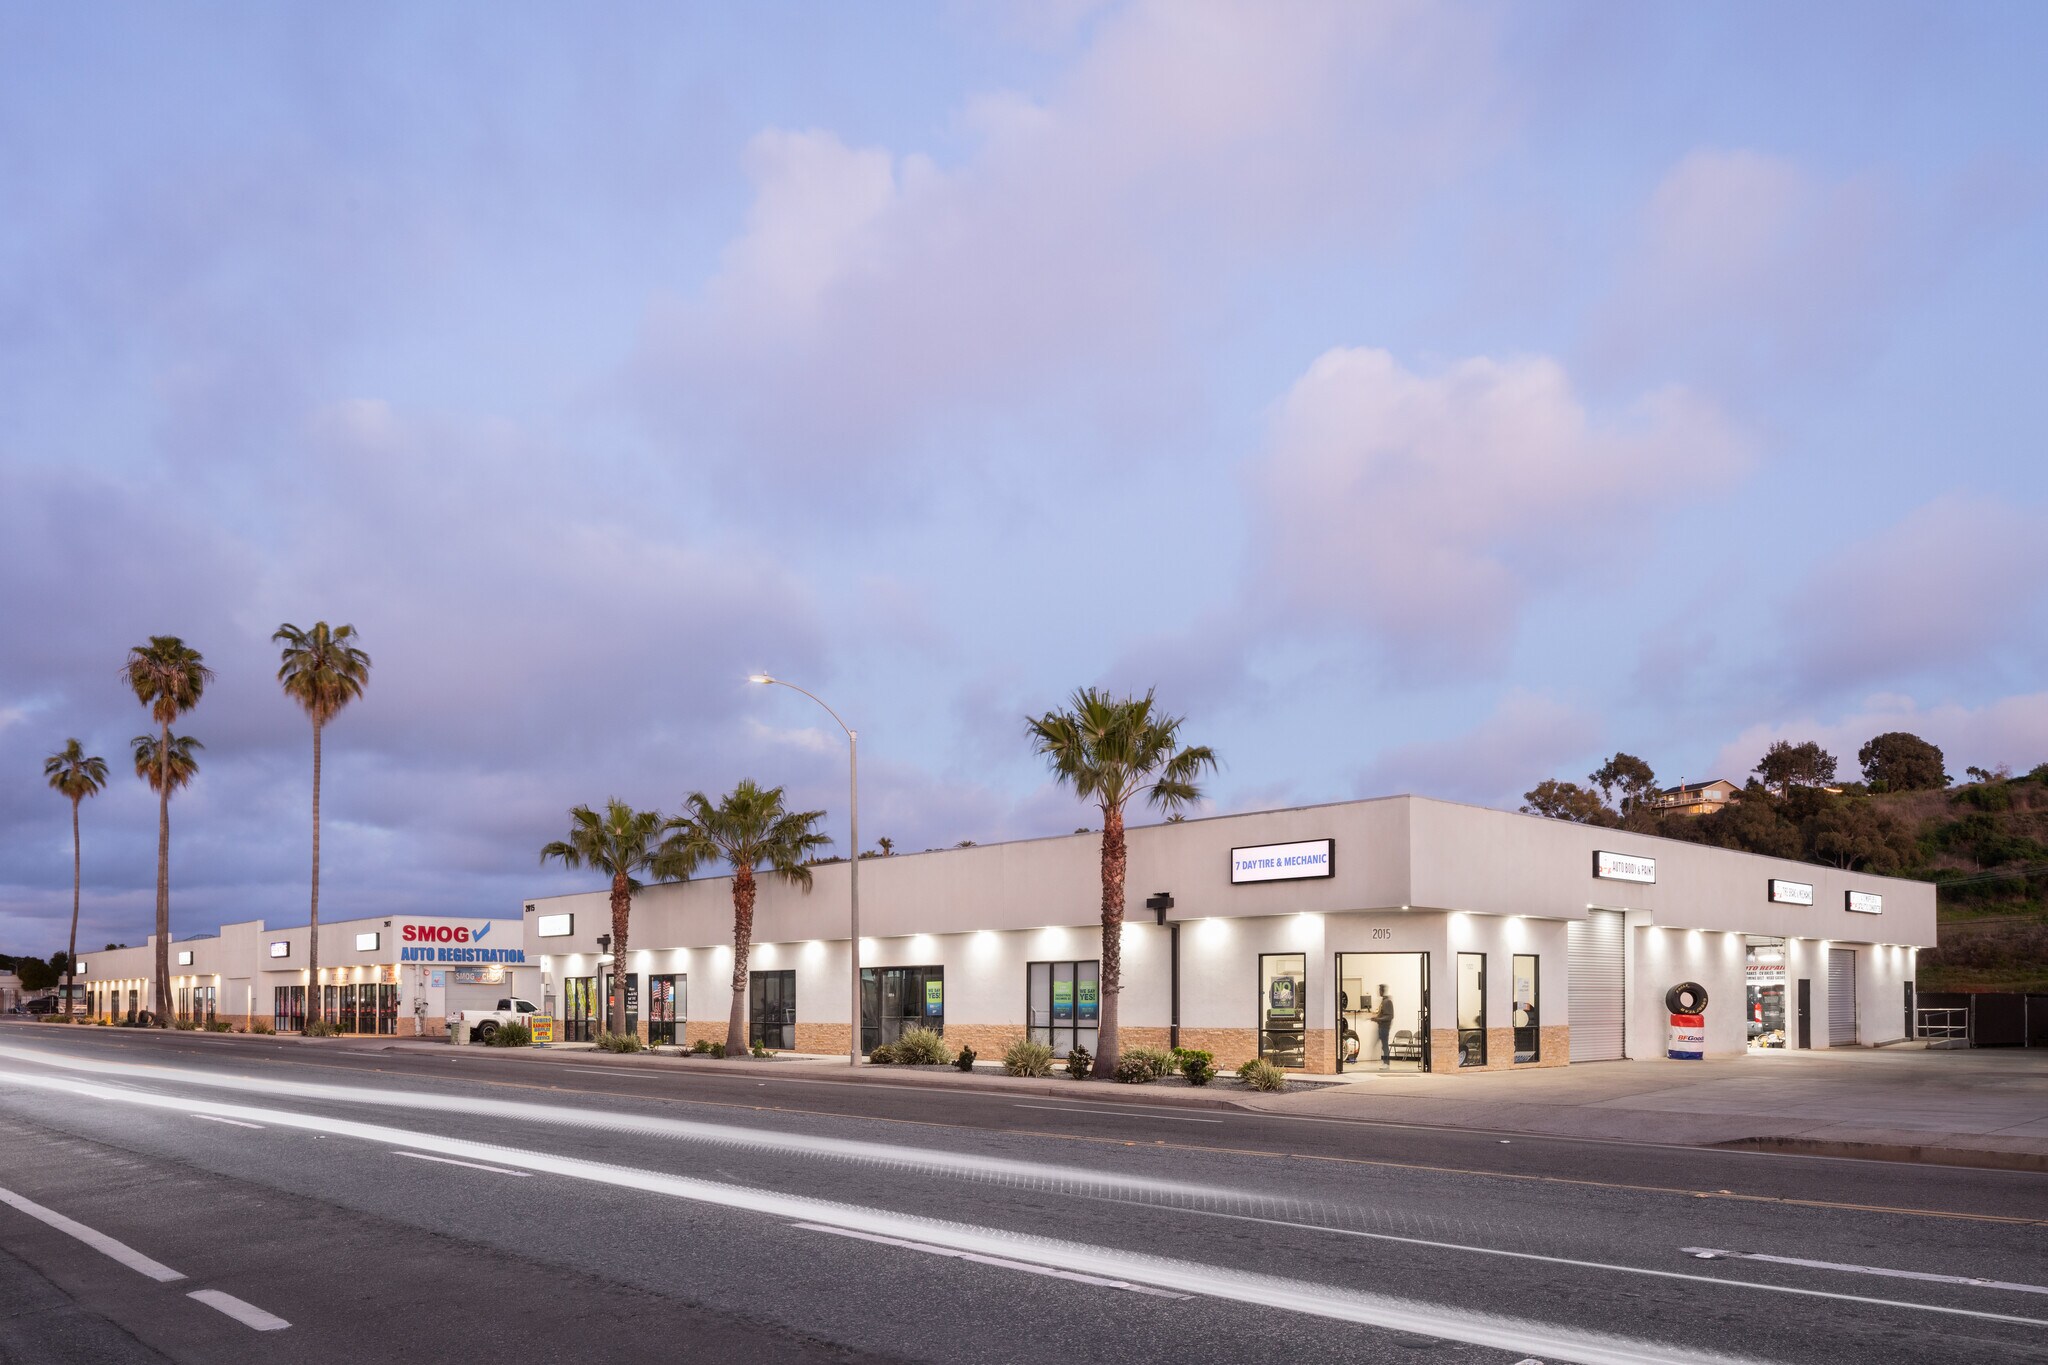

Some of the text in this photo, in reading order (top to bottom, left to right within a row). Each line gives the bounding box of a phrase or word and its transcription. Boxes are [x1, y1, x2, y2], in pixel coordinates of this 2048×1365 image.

[1235, 853, 1327, 870] 7 DAY TIRE & MECHANIC
[1612, 860, 1624, 872] AUTO
[1625, 862, 1637, 874] BODY
[1641, 864, 1654, 876] PAINT
[402, 924, 469, 943] SMOG
[1372, 928, 1391, 940] 2015
[401, 946, 525, 963] AUTO REGISTRATION
[455, 972, 475, 981] SMOG
[1273, 982, 1292, 992] NO
